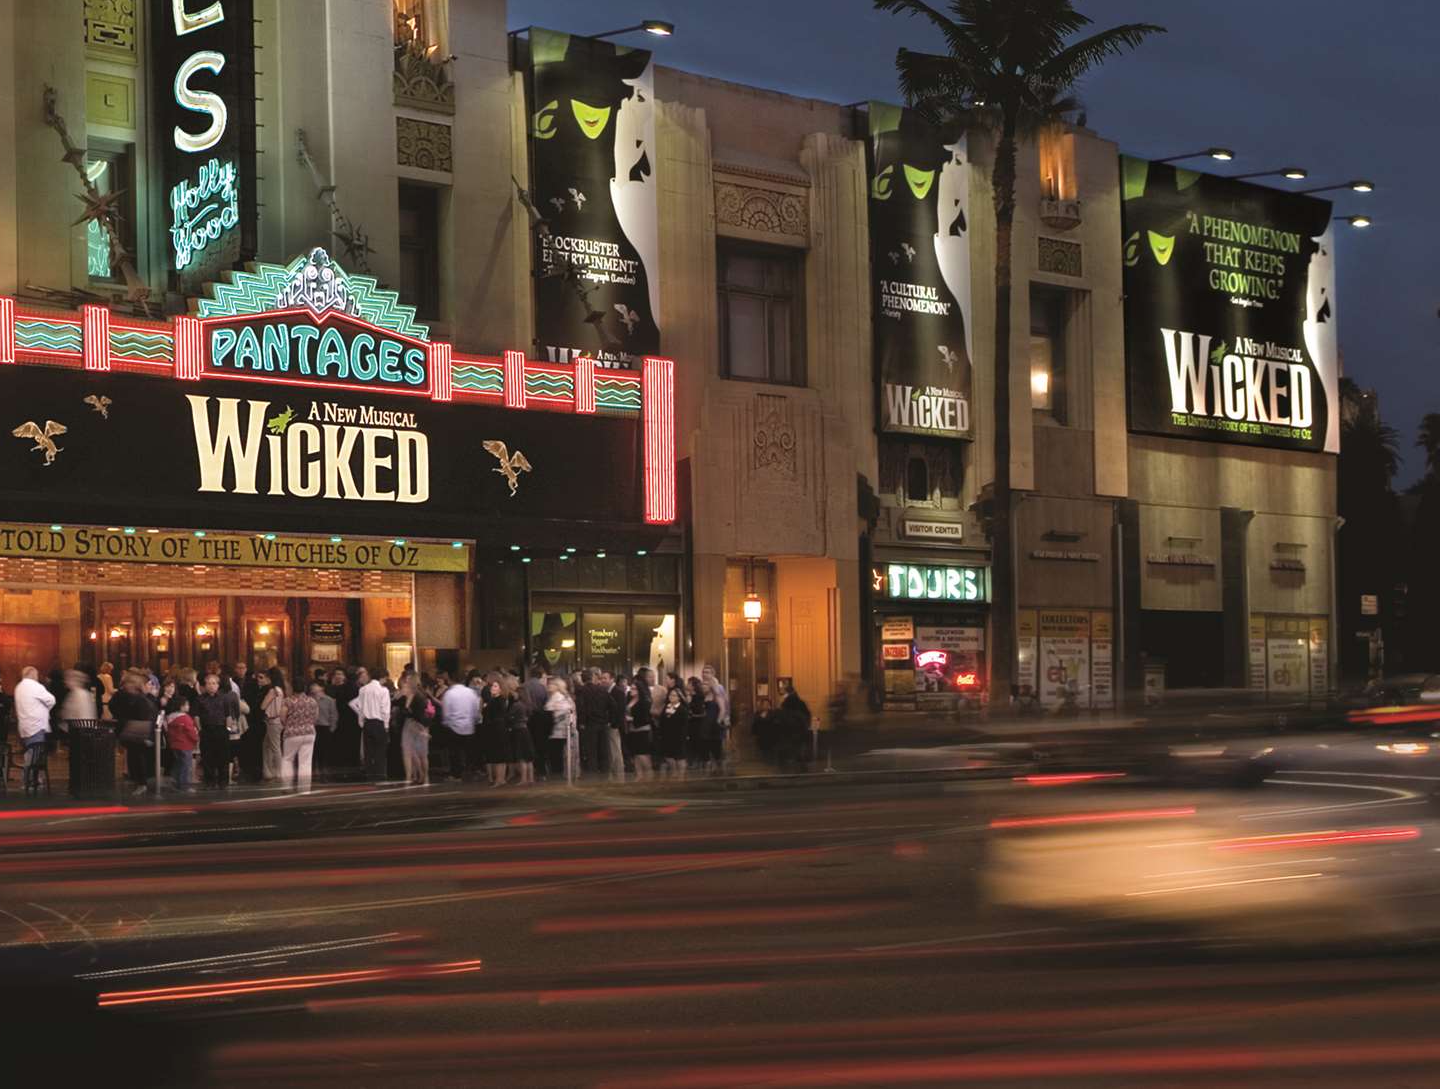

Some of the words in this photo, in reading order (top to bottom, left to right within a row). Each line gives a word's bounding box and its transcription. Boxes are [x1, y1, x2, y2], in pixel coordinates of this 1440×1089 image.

[1203, 215, 1301, 253] PHENOMENON
[1203, 241, 1241, 268] THAT
[1244, 249, 1285, 276] KEEPS
[889, 281, 938, 300] CULTURAL
[212, 324, 425, 385] PANTAGES
[1235, 336, 1243, 354] A
[308, 401, 320, 420] A
[75, 529, 152, 557] STORY
[161, 537, 190, 558] OF
[198, 539, 242, 560] THE
[249, 537, 347, 564] WITCHES
[355, 544, 381, 565] OF
[389, 542, 419, 567] OZ
[887, 566, 977, 600] TOURS
